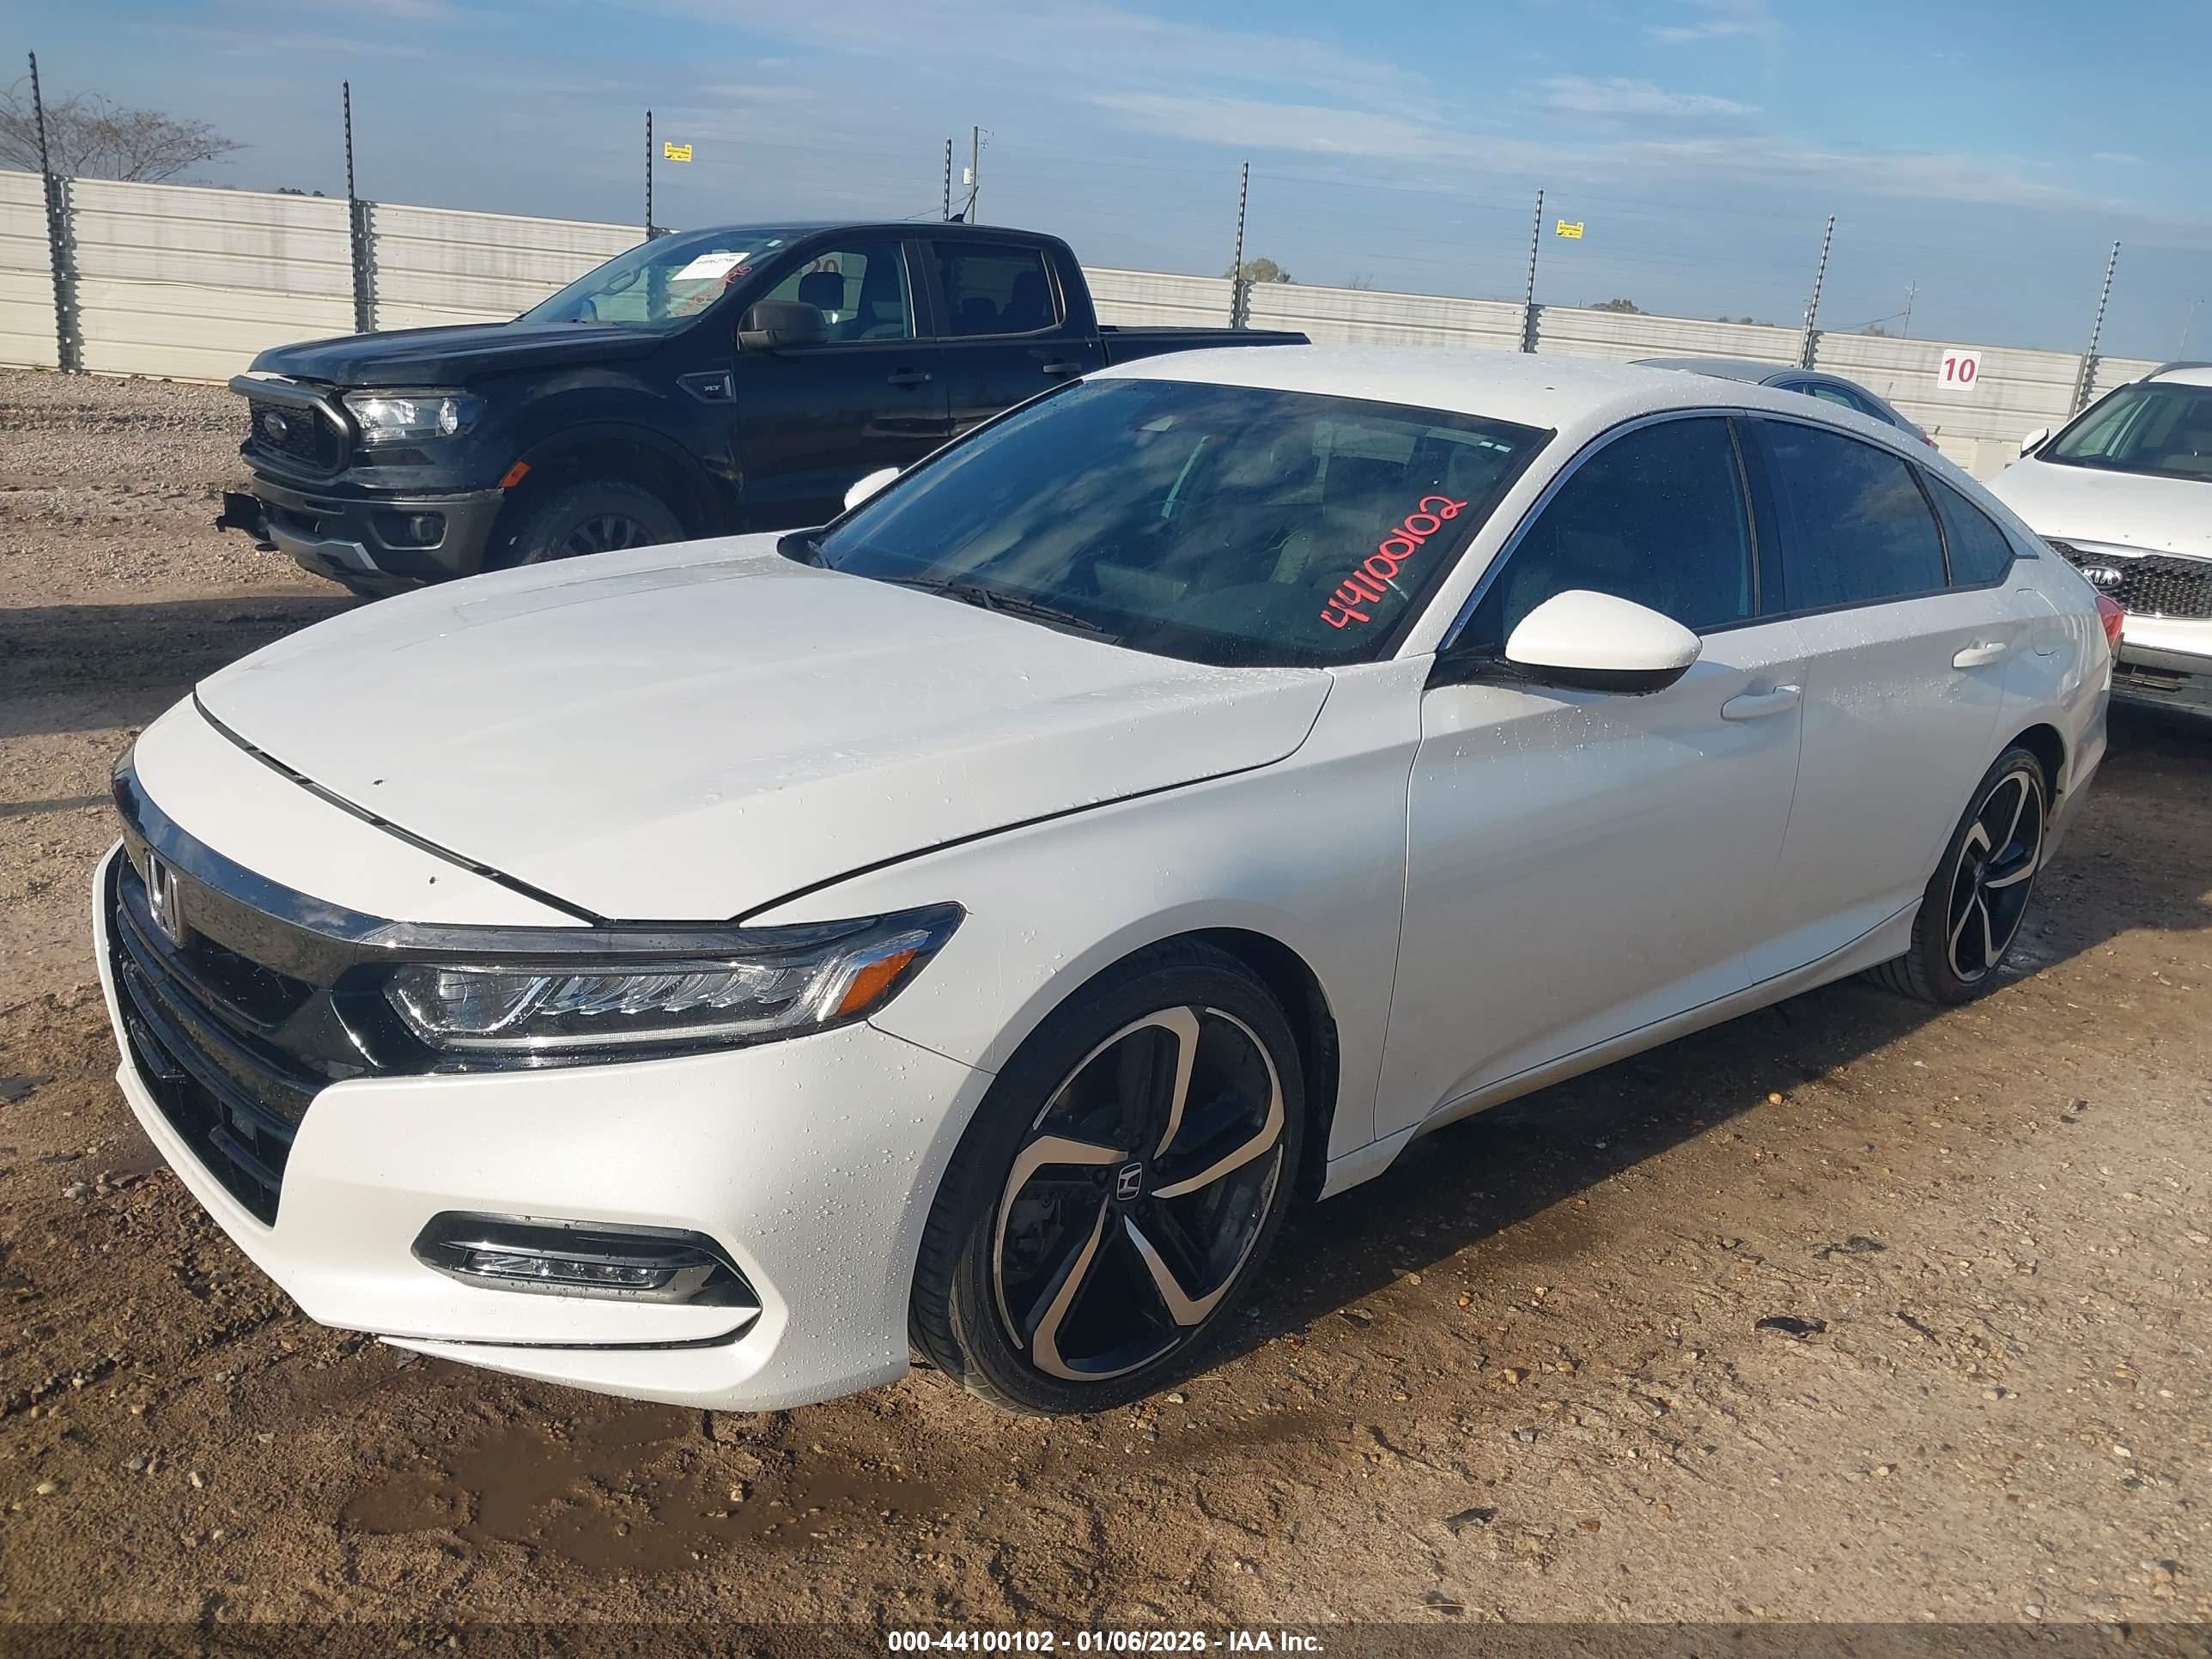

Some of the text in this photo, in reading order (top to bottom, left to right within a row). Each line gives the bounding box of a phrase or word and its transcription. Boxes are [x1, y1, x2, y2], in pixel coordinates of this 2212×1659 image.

[1944, 357, 1976, 383] 10
[1320, 495, 1468, 629] 44100102
[2083, 568, 2114, 585] KIA
